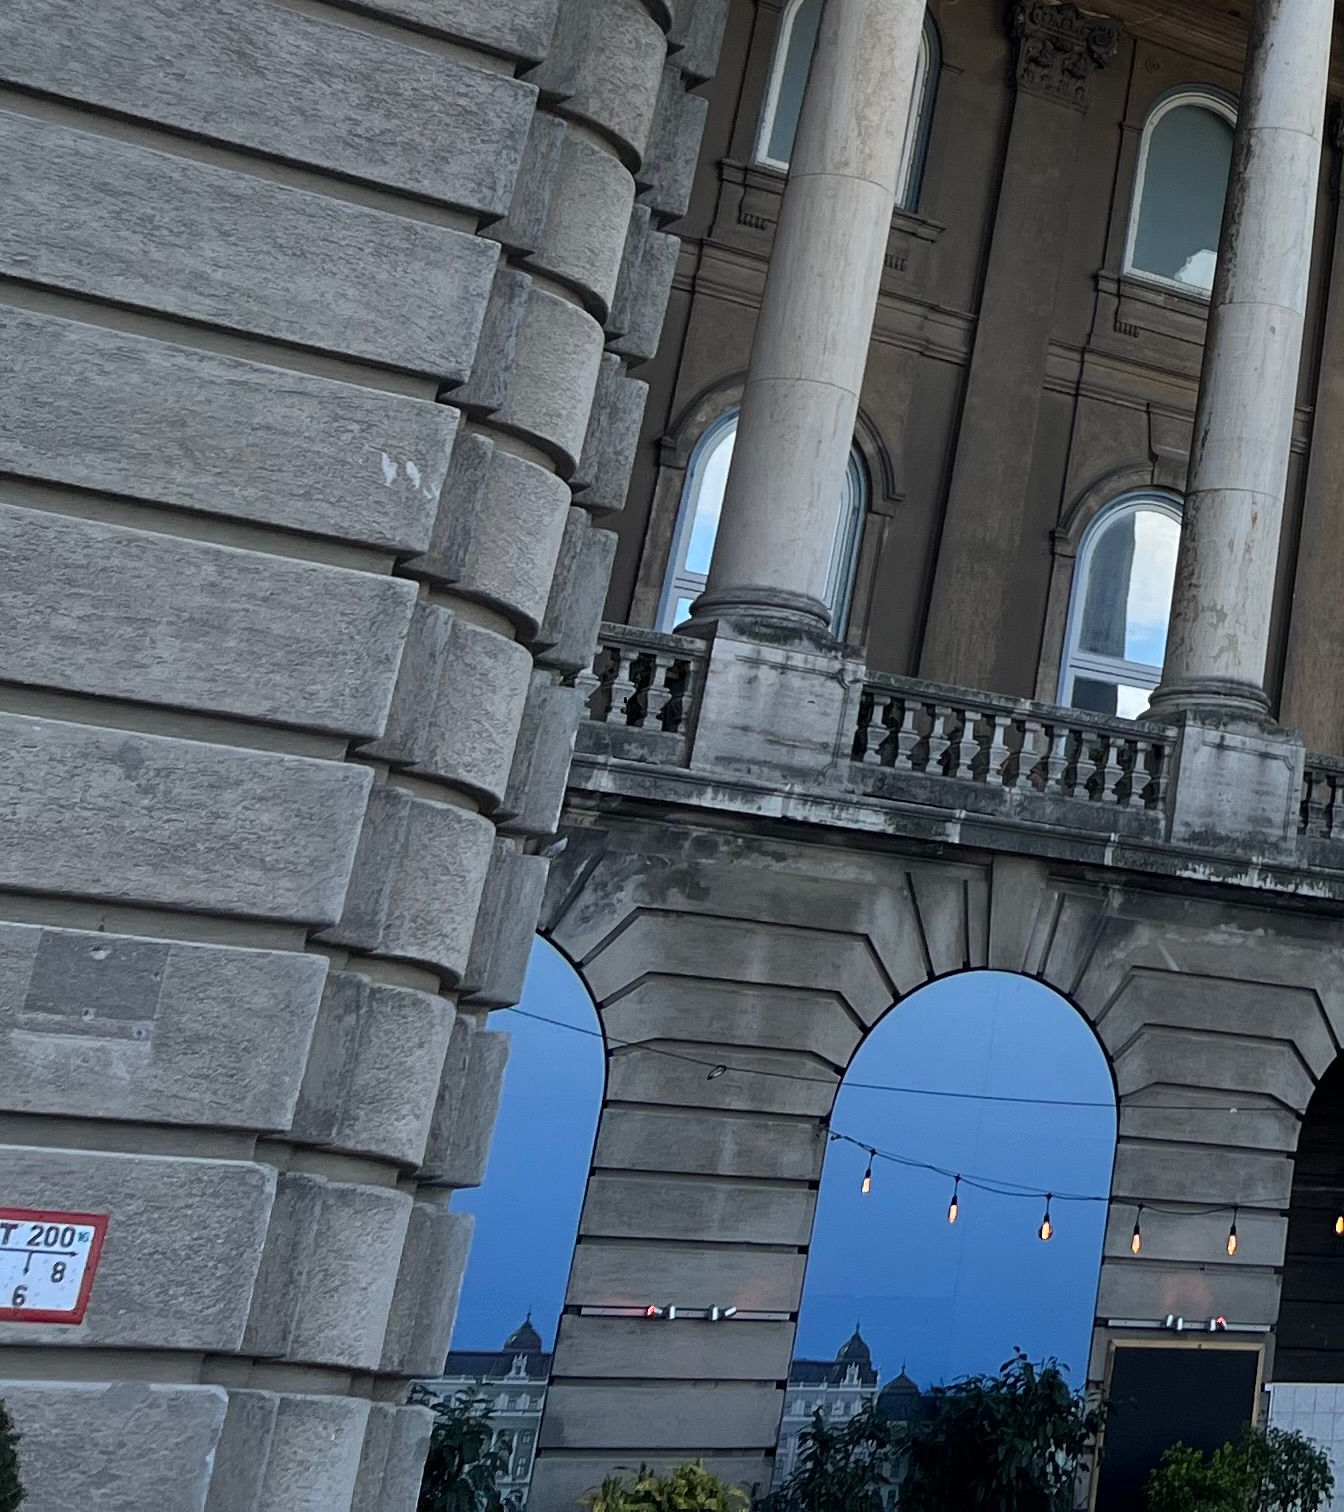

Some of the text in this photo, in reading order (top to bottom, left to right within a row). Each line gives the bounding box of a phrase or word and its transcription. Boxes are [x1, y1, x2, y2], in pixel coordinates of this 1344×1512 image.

[26, 1225, 76, 1248] 200
[50, 1261, 66, 1283] 8
[12, 1285, 27, 1306] 6
